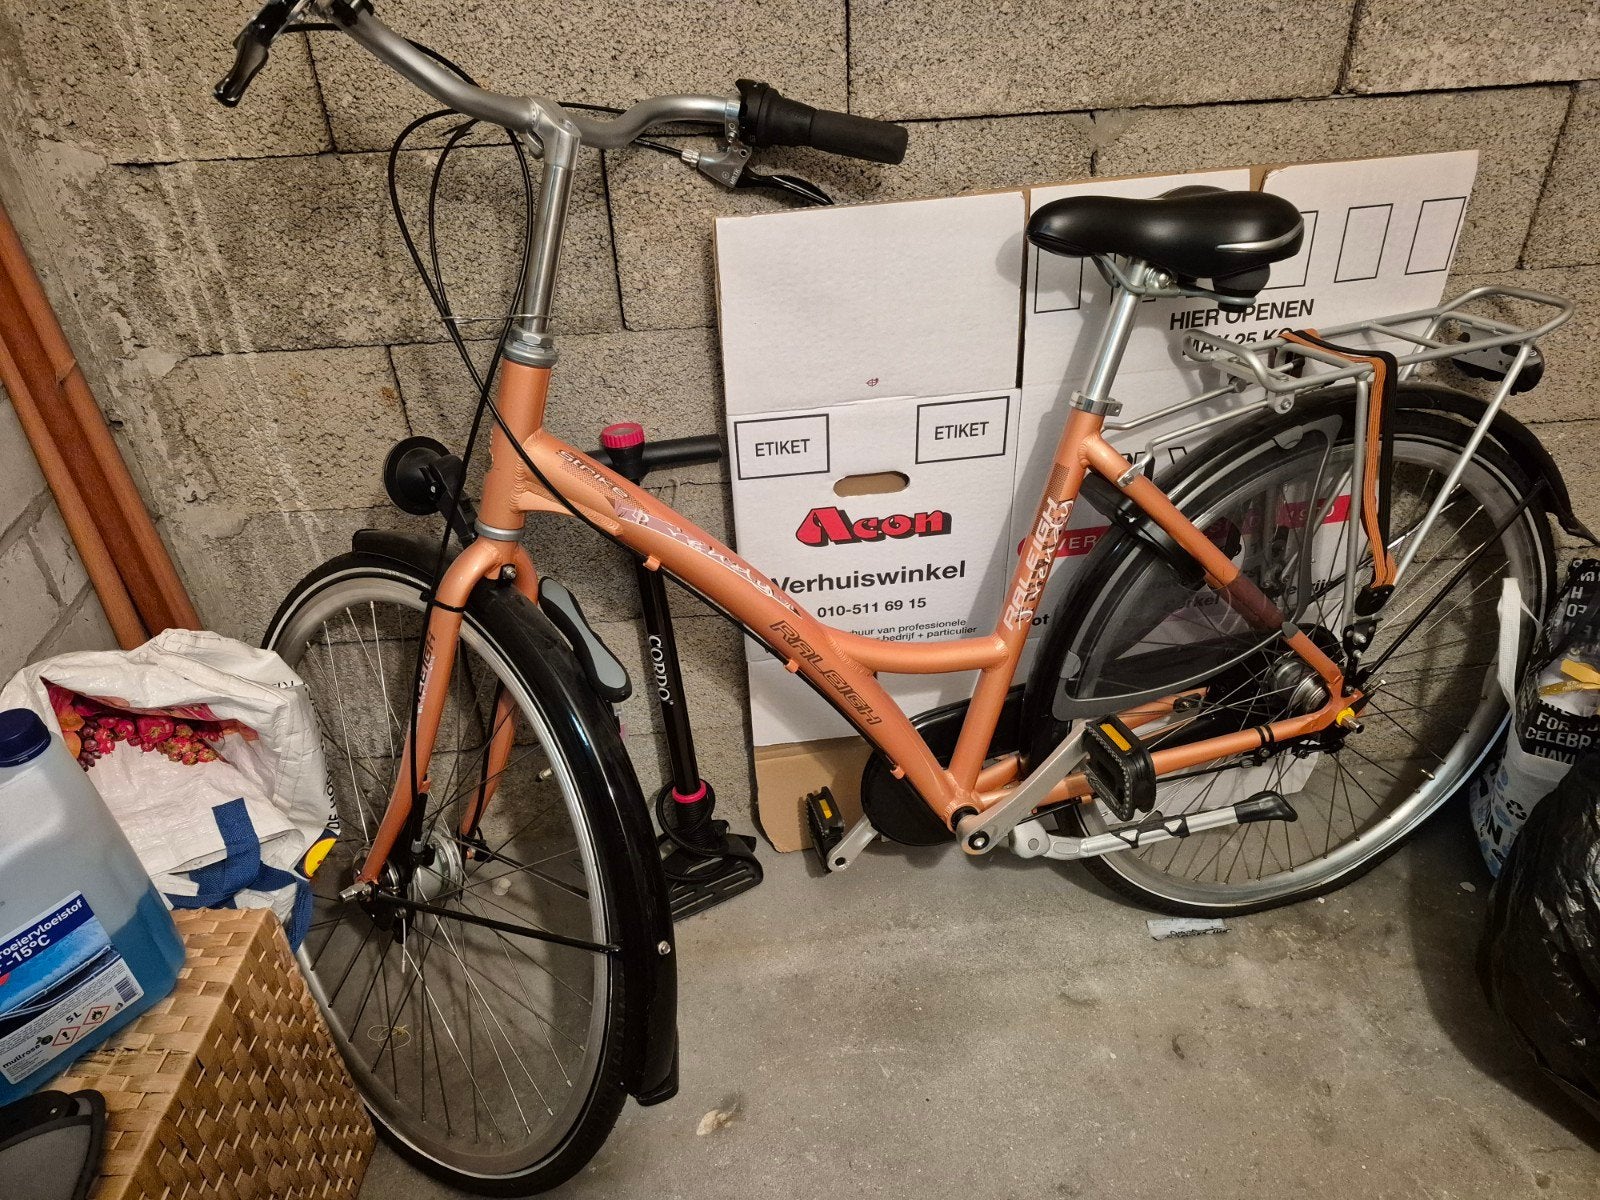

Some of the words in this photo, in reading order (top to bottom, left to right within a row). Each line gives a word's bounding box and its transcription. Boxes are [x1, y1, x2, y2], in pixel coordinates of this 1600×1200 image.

[1169, 308, 1220, 331] HIER
[1225, 298, 1315, 325] OPENEN
[934, 421, 990, 440] ETIKET
[755, 438, 811, 457] ETIKET
[795, 505, 952, 547] Acon
[771, 560, 966, 594] Verhuiswinkel
[1003, 496, 1059, 632] RALEIGH
[817, 601, 879, 618] 010-511
[884, 599, 903, 612] 69
[909, 597, 927, 609] 15
[877, 625, 896, 635] van
[900, 618, 967, 633] professionele
[927, 626, 978, 639] particulier
[769, 619, 883, 726] RALEIGH
[0, 898, 83, 960] roeiervloeistof
